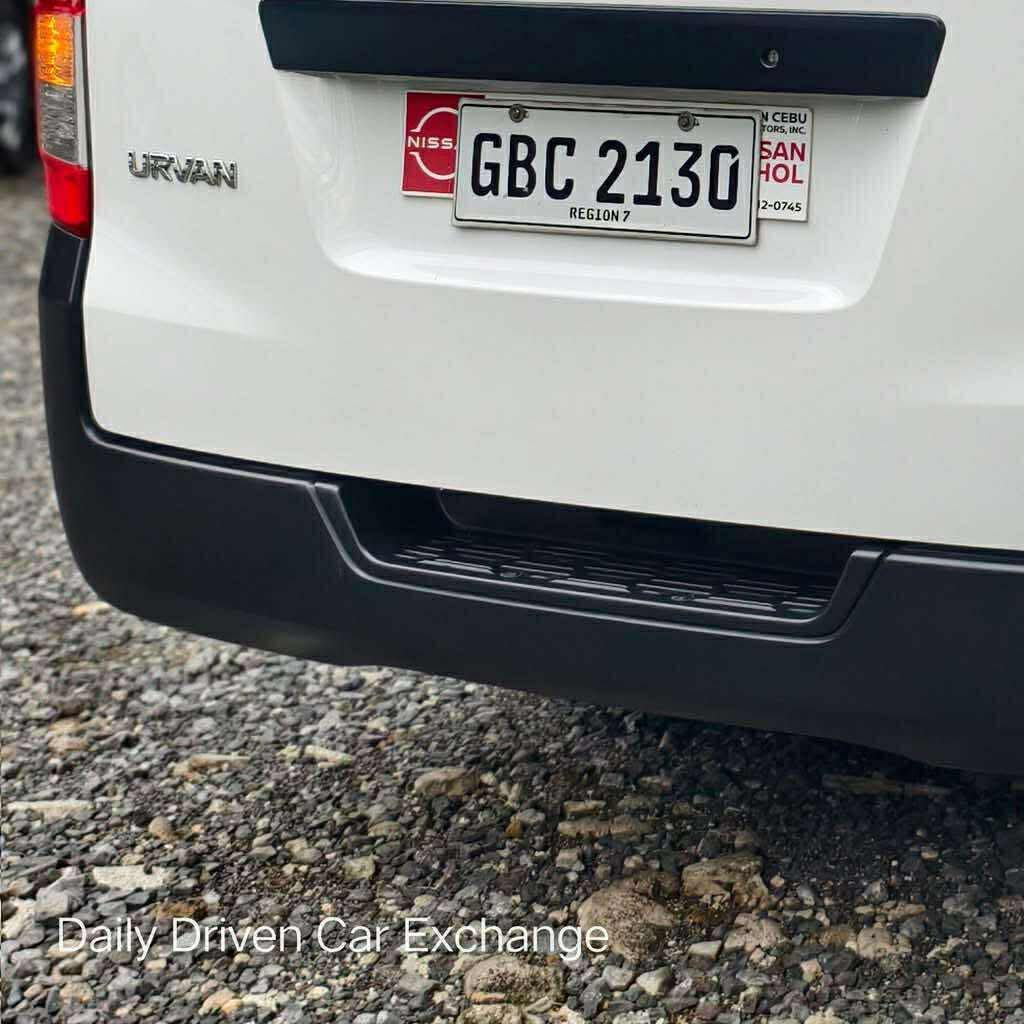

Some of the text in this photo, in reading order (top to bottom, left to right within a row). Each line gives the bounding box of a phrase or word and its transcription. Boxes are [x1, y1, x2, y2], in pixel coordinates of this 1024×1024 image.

[772, 111, 808, 124] CEBU
[761, 124, 788, 135] TORS,
[407, 135, 457, 150] NISS
[759, 140, 806, 162] SAN
[128, 150, 239, 189] URVAN
[471, 132, 740, 210] GBC 2130
[759, 162, 804, 184] HOL
[757, 199, 802, 212] 12-0745
[570, 207, 632, 223] REGION 7
